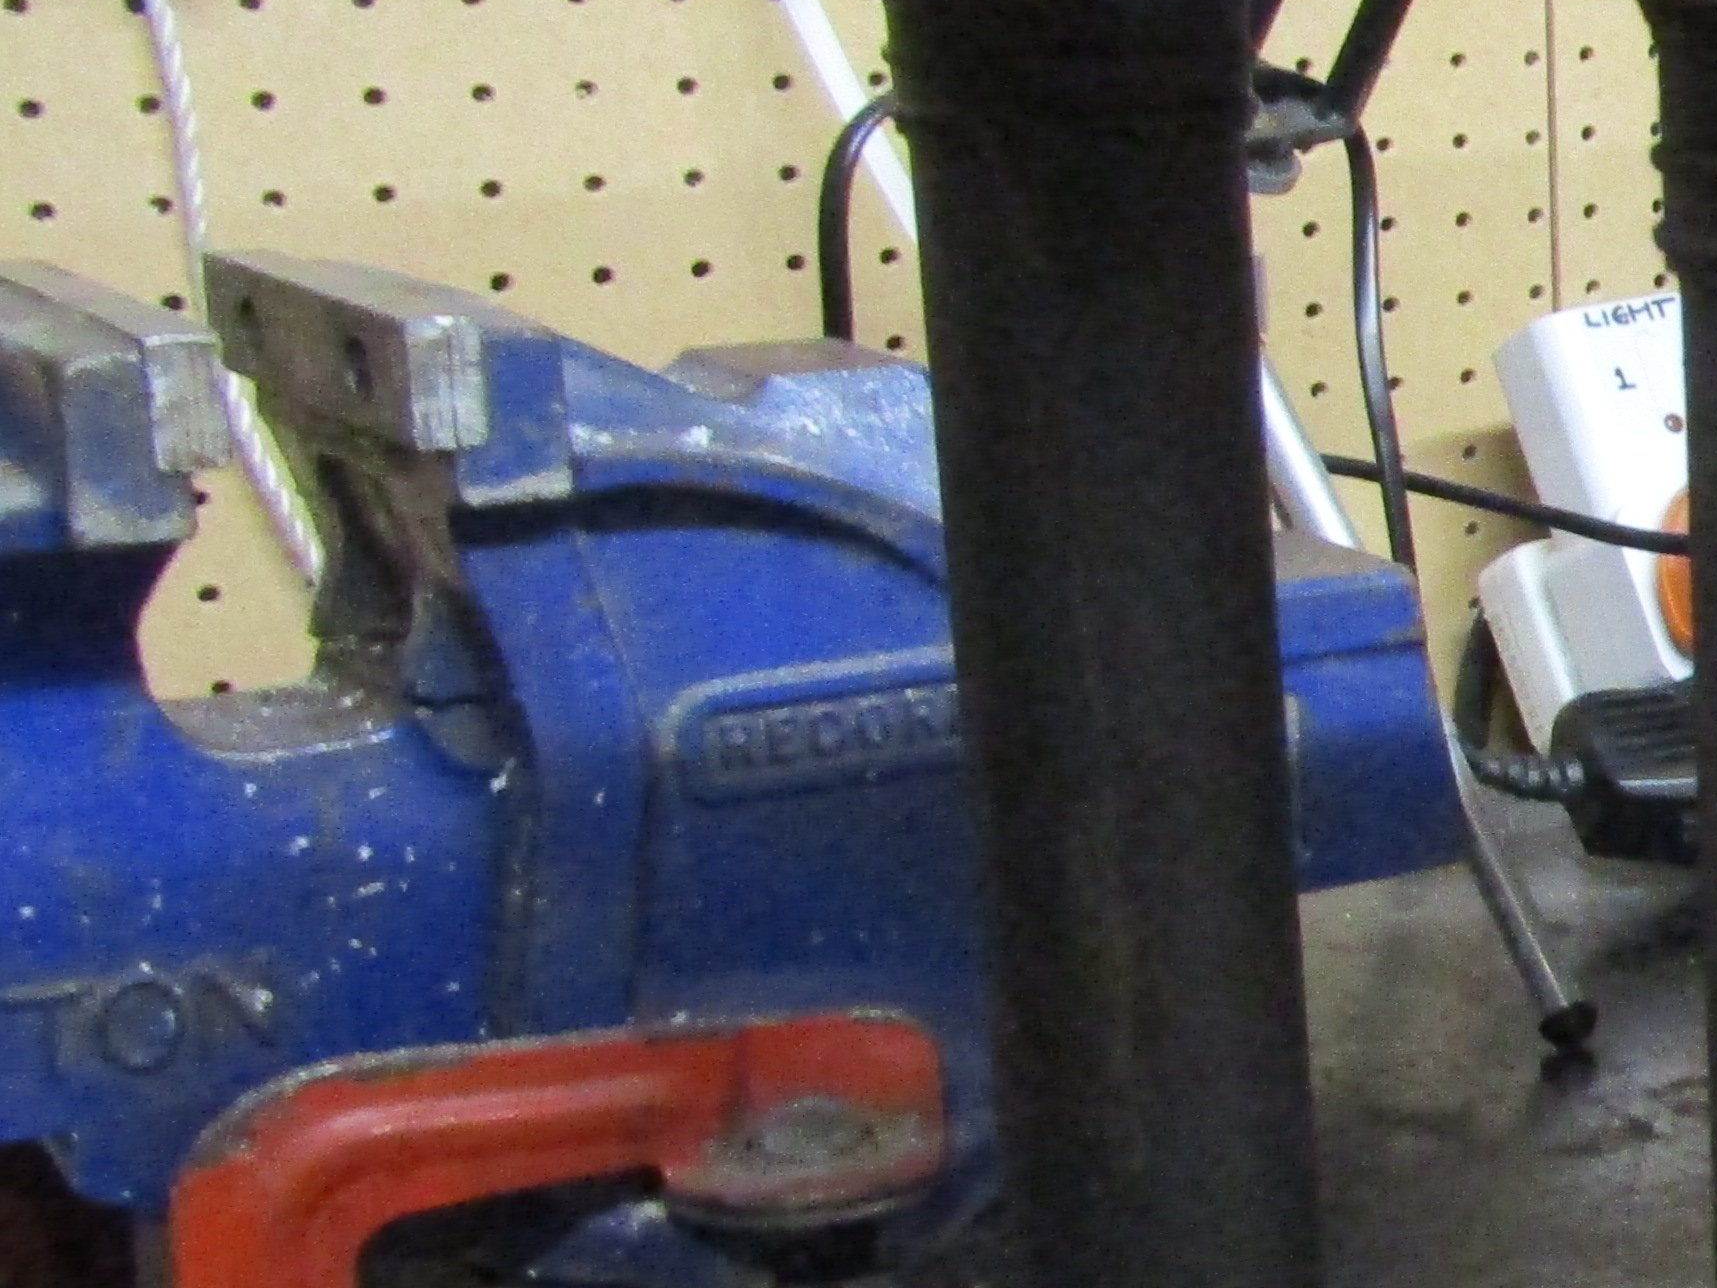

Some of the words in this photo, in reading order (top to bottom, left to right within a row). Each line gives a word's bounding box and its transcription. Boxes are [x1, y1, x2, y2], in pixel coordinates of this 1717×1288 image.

[1583, 296, 1676, 328] LIGHT
[1613, 366, 1638, 391] 1
[708, 687, 958, 774] RECOR
